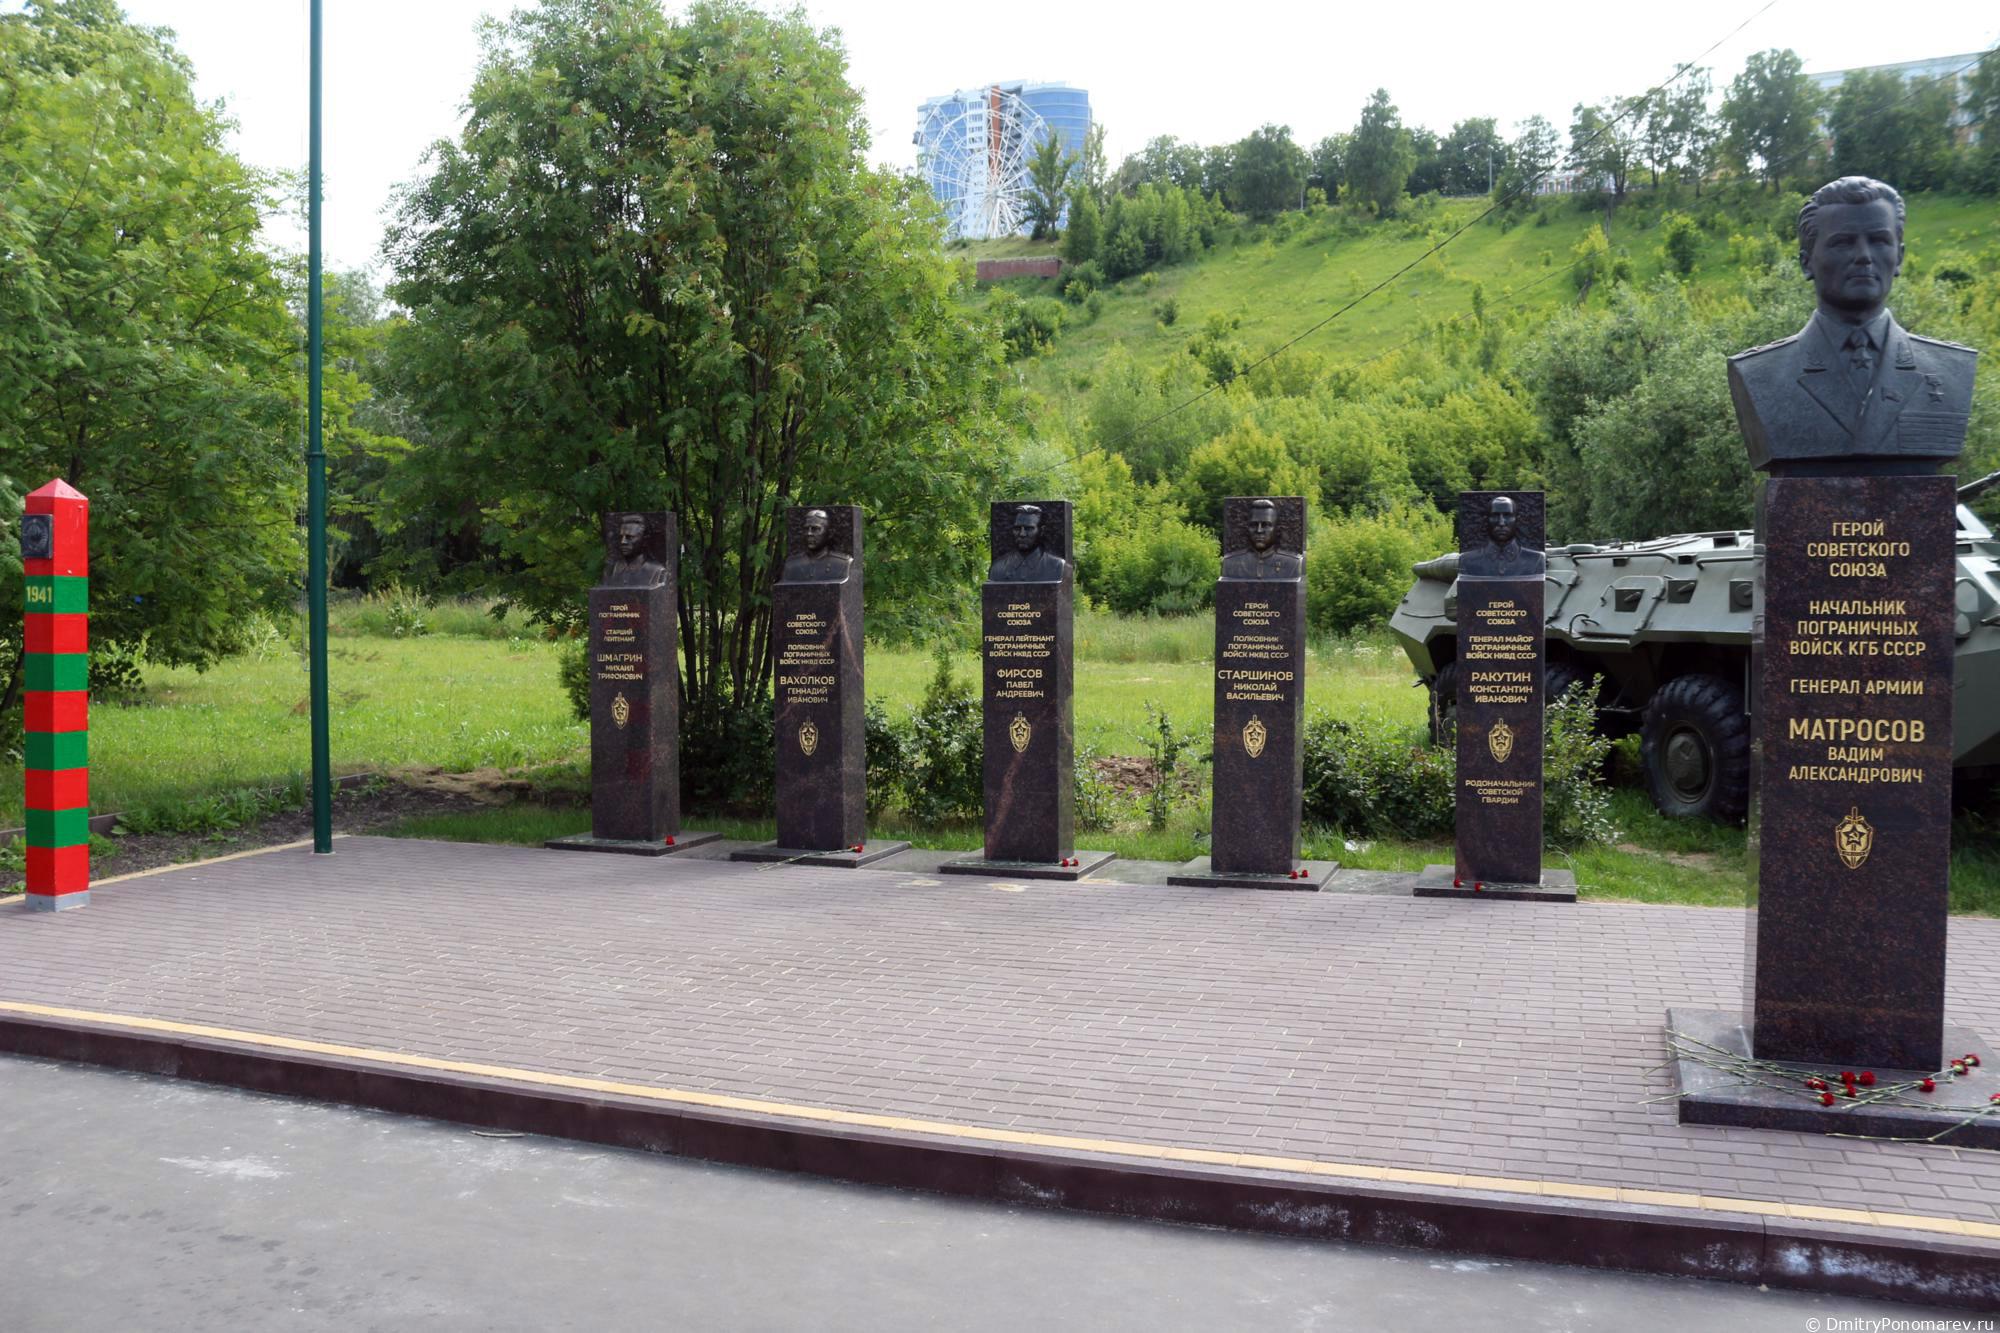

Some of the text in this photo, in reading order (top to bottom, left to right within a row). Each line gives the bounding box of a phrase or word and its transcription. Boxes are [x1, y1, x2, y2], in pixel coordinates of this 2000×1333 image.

[1832, 519, 1884, 536] ГЕРОЙ
[1807, 542, 1910, 557] СОВЕТСКОГО
[1829, 563, 1887, 577] СОЮЗА
[25, 585, 52, 603] 1941
[1008, 602, 1031, 611] ГЕРОЙ
[1488, 600, 1515, 609] ГЕРОЙ
[1809, 600, 1906, 616] НАЧАЛЬНИК
[796, 612, 817, 621] ГЕРОЙ
[1233, 610, 1281, 618] СОВЕТСКОГО
[1476, 609, 1527, 618] СОВЕТСКОГО
[1797, 620, 1919, 636] ПОГРАНИЧНЫХ
[1233, 635, 1279, 643] ПОЛКОВНИК
[1469, 634, 1534, 643] ГЕНЕРАЛ МАЙОР
[1228, 643, 1284, 651] ПОГРАНИЧНЫХ
[1472, 643, 1532, 652] ПОГРАНИЧНЫХ
[1789, 638, 1926, 656] ВОЙСК КГБ СССР
[597, 653, 643, 662] ШМАГРИН
[989, 649, 1012, 657] ВОЙСК
[1223, 650, 1248, 658] ВОЙСК
[1249, 651, 1270, 659] НКВД
[1466, 650, 1537, 661] ВОЙСК НКВД СССР
[606, 664, 634, 672] МИХАИЛ
[996, 668, 1043, 679] ФИРСОВ
[1218, 669, 1294, 681] СТАРШИНОВ
[1472, 672, 1532, 682] РАКУТИН
[780, 676, 836, 685] ВАХОЛКОВ
[1006, 681, 1034, 689] ПАВЕЛ
[787, 686, 828, 695] ГЕННАДИЙ
[1234, 682, 1277, 691] НИКОЛАЙ
[1470, 685, 1533, 694] КОНСТАНТИН
[1790, 679, 1924, 695] ГЕНЕРАЛ АРМИИ
[996, 690, 1044, 699] АНДРЕЕВИЧ
[1226, 692, 1284, 701] ВАСИЛЬЕВИЧ
[1475, 694, 1527, 704] ИВАНОВИЧ
[787, 696, 829, 704] ИВАНОВИЧ
[1789, 718, 1925, 742] МАТРОСОВ
[1828, 747, 1884, 762] ВАДИМ
[1789, 766, 1923, 784] АЛЕКСАНДРОВИЧ
[1465, 779, 1536, 788] РОДОНАЧАЛЬНИК
[1477, 787, 1524, 796] СОВЕТСКОЙ
[1482, 796, 1519, 805] ГВАРДИИ
